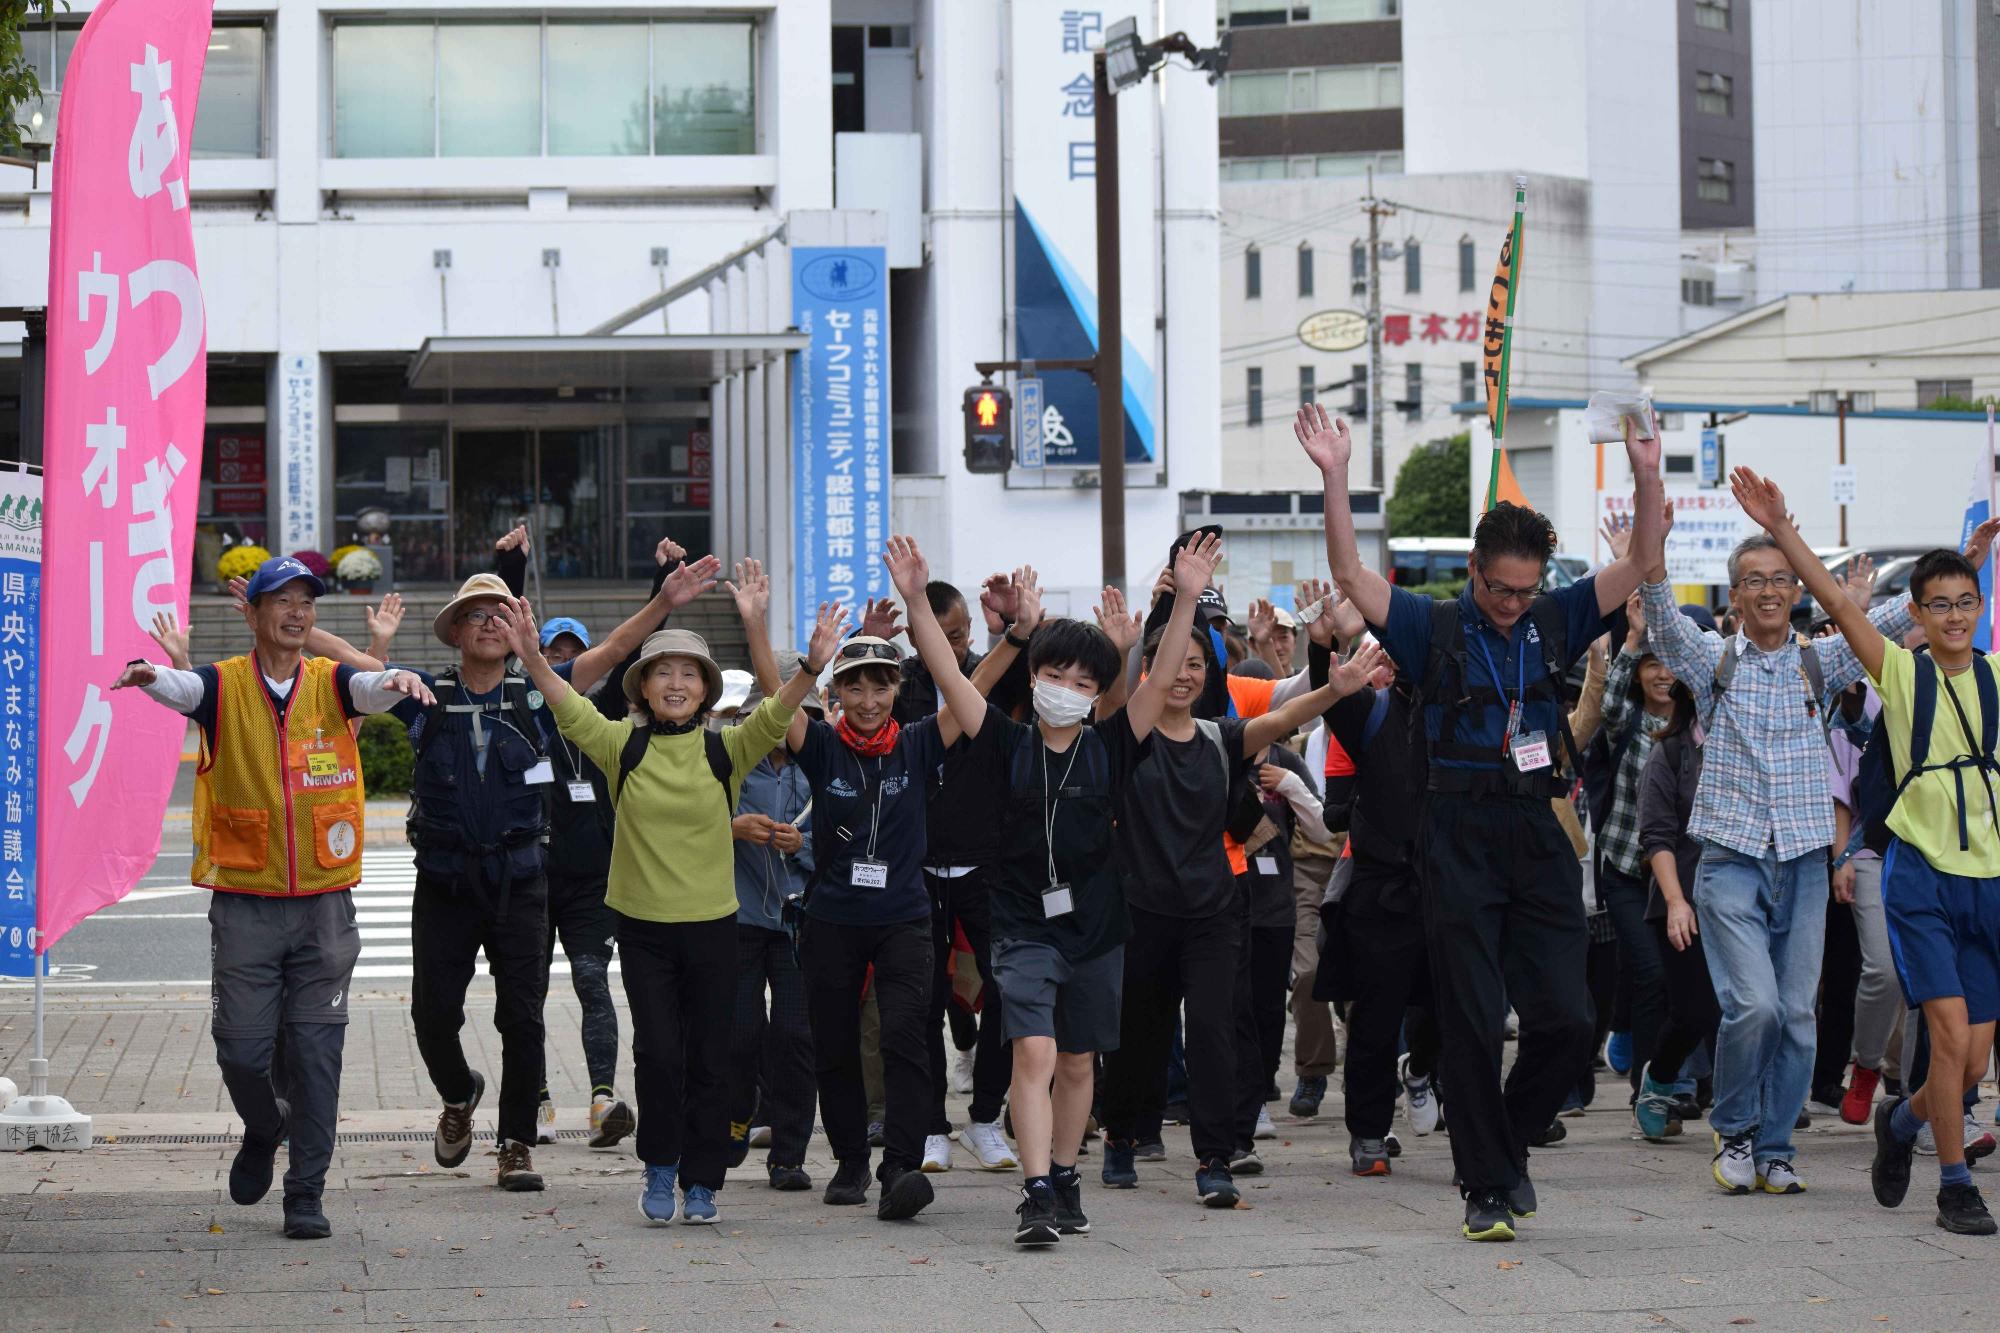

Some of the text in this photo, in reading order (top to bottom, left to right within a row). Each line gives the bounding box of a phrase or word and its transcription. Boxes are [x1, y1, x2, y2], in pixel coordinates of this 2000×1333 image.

[1060, 11, 1101, 181] 記念日
[128, 43, 205, 634] あつぎ
[1023, 387, 1038, 462] 押ボタン式
[2, 572, 26, 900] 県央やまなみ協議会
[303, 768, 356, 787] Network
[6, 1124, 79, 1145] 体育協会
